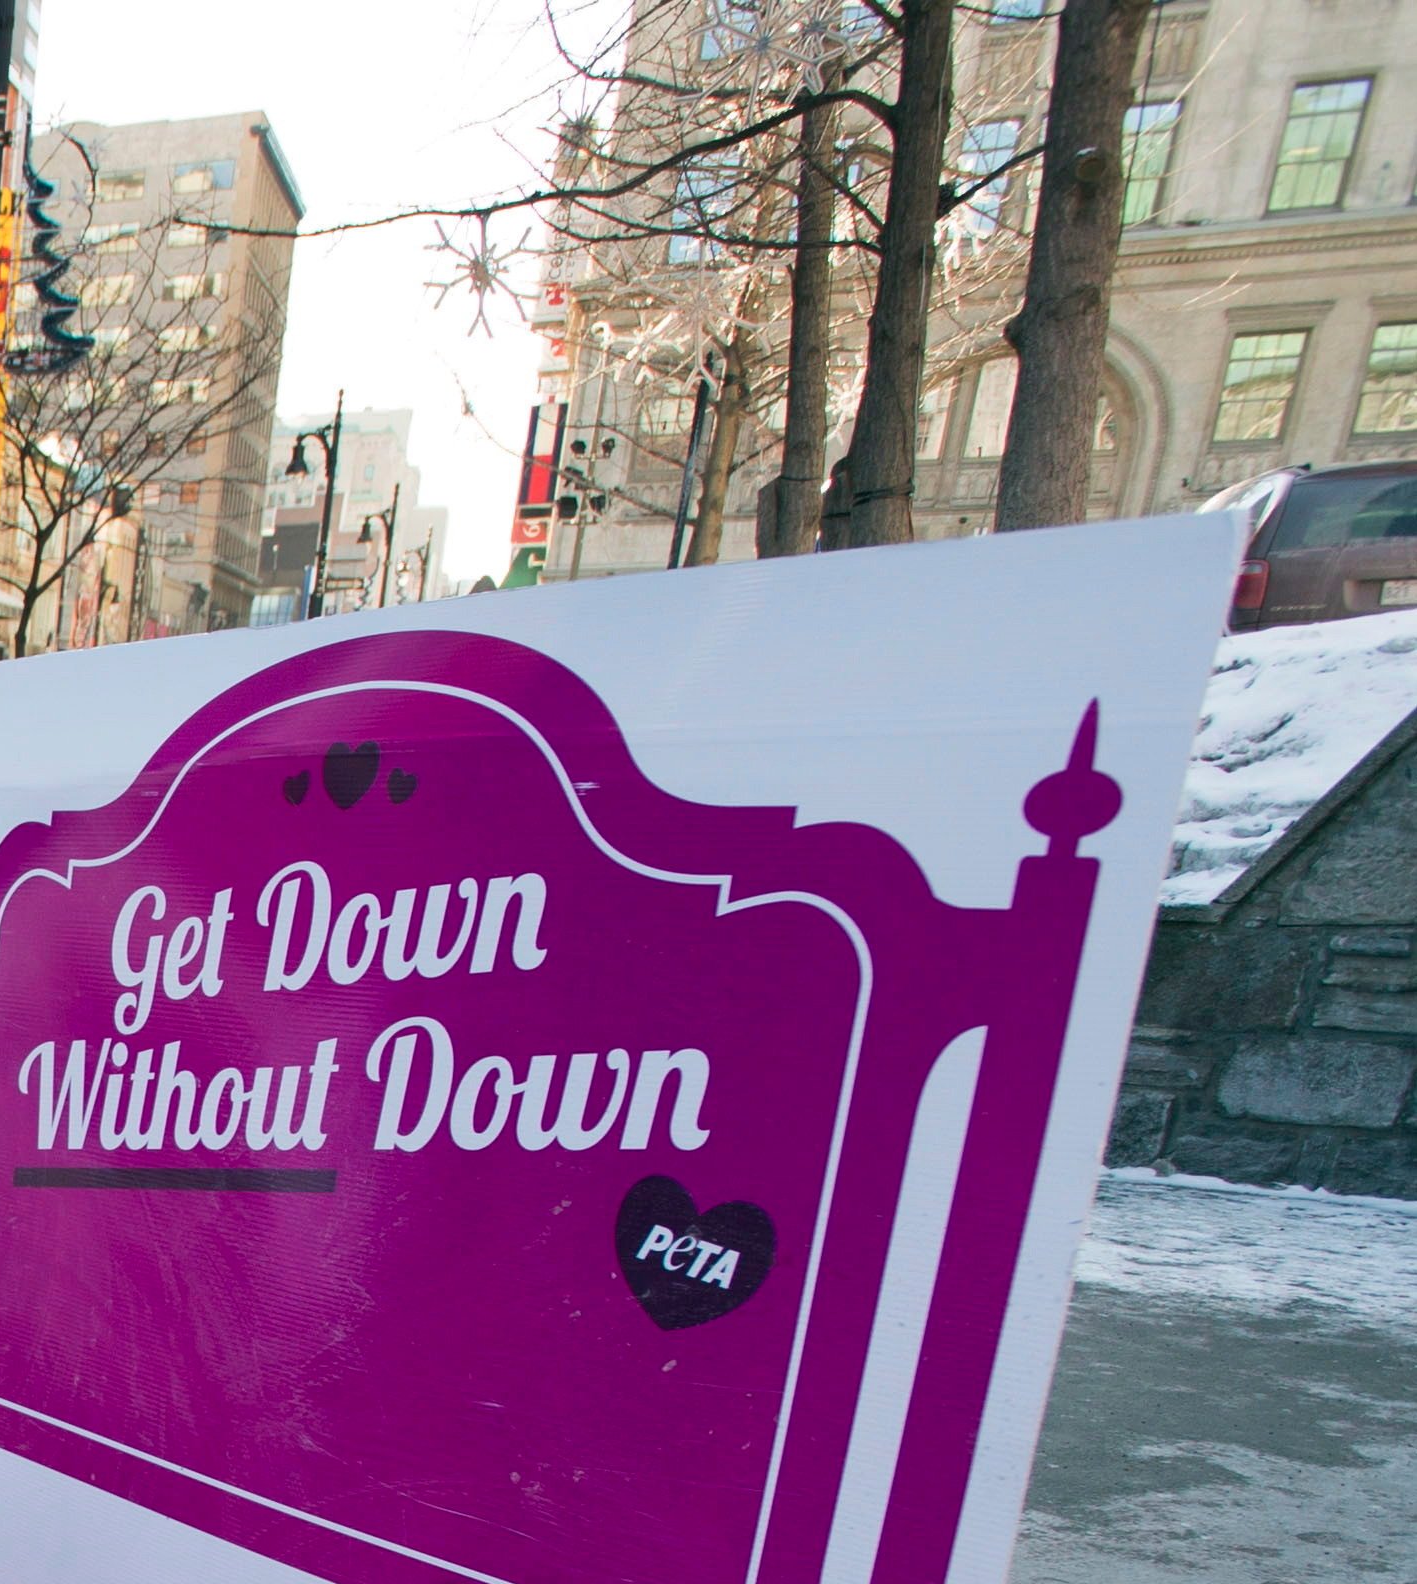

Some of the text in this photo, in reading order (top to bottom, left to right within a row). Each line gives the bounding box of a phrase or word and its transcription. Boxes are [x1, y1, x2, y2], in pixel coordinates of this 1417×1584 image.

[111, 861, 547, 1035] Get Down
[18, 1016, 709, 1152] Without Down
